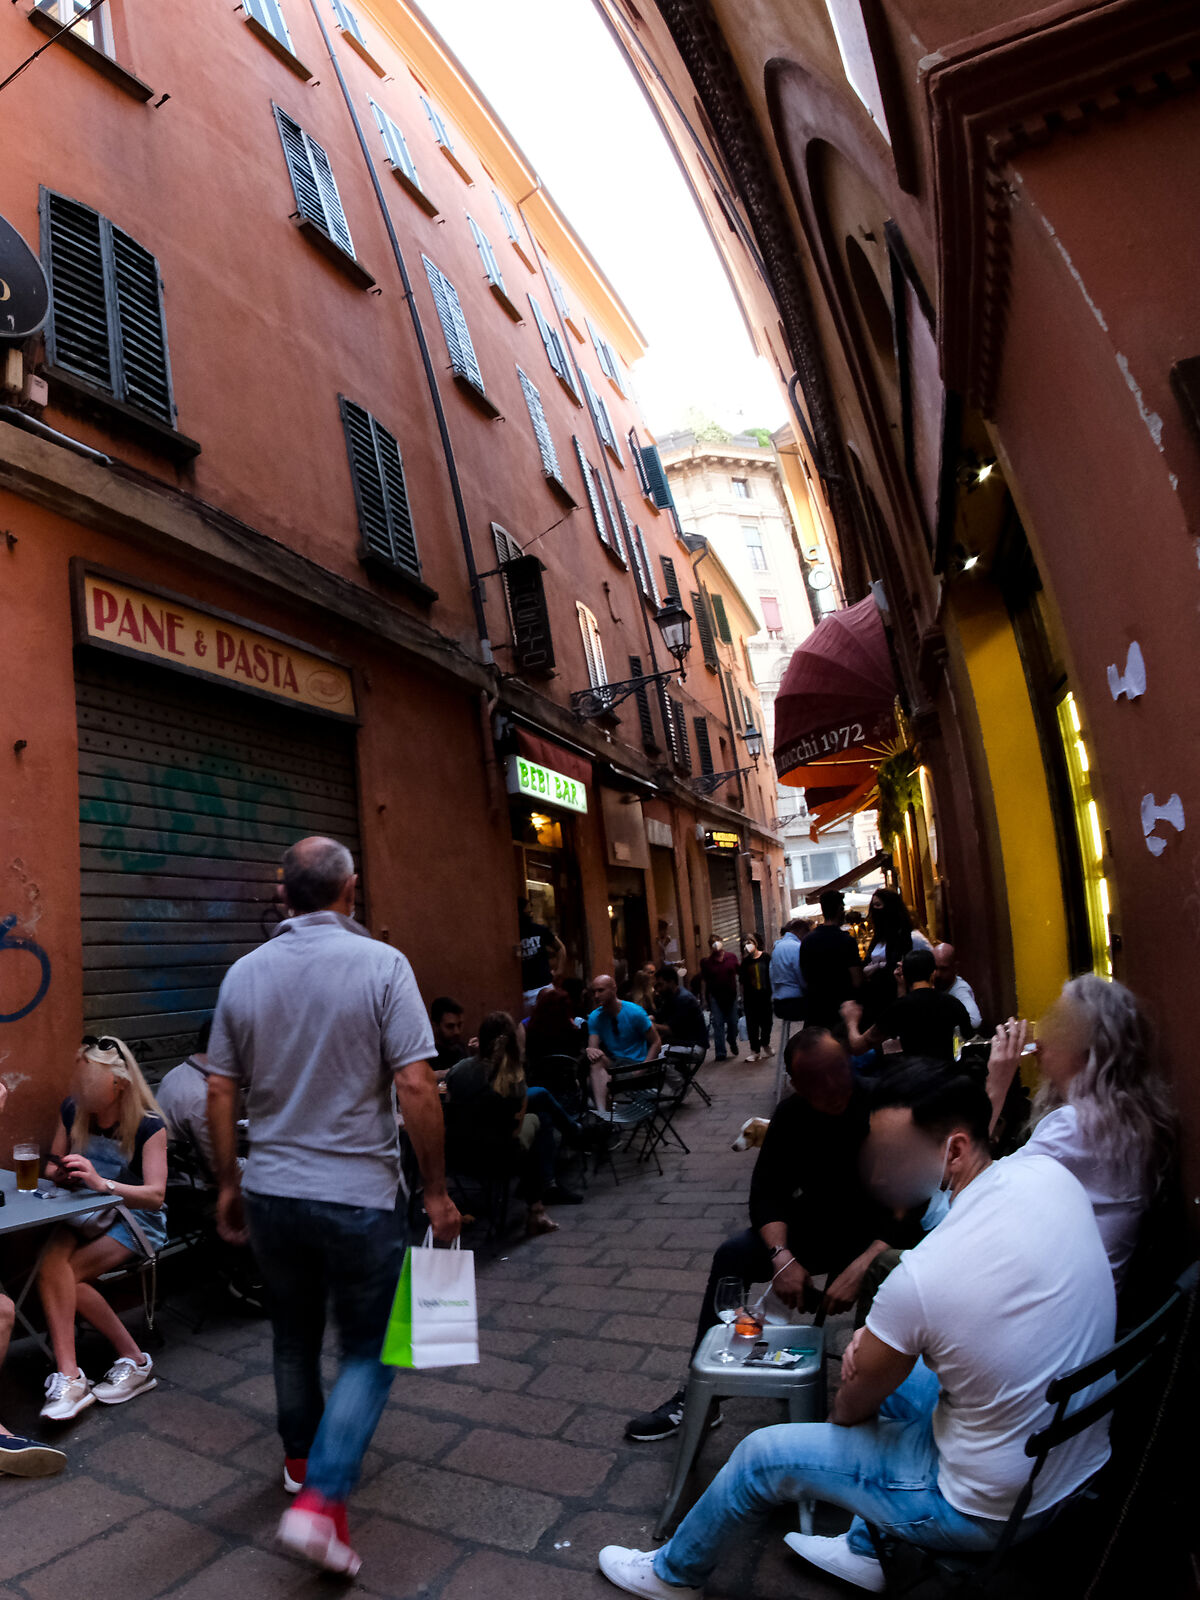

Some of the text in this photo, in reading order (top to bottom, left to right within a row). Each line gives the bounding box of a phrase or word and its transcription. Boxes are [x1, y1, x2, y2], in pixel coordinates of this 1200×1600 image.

[93, 587, 300, 694] PANE & PASTA
[820, 722, 866, 753] 1972
[519, 762, 578, 806] BEBI BAR
